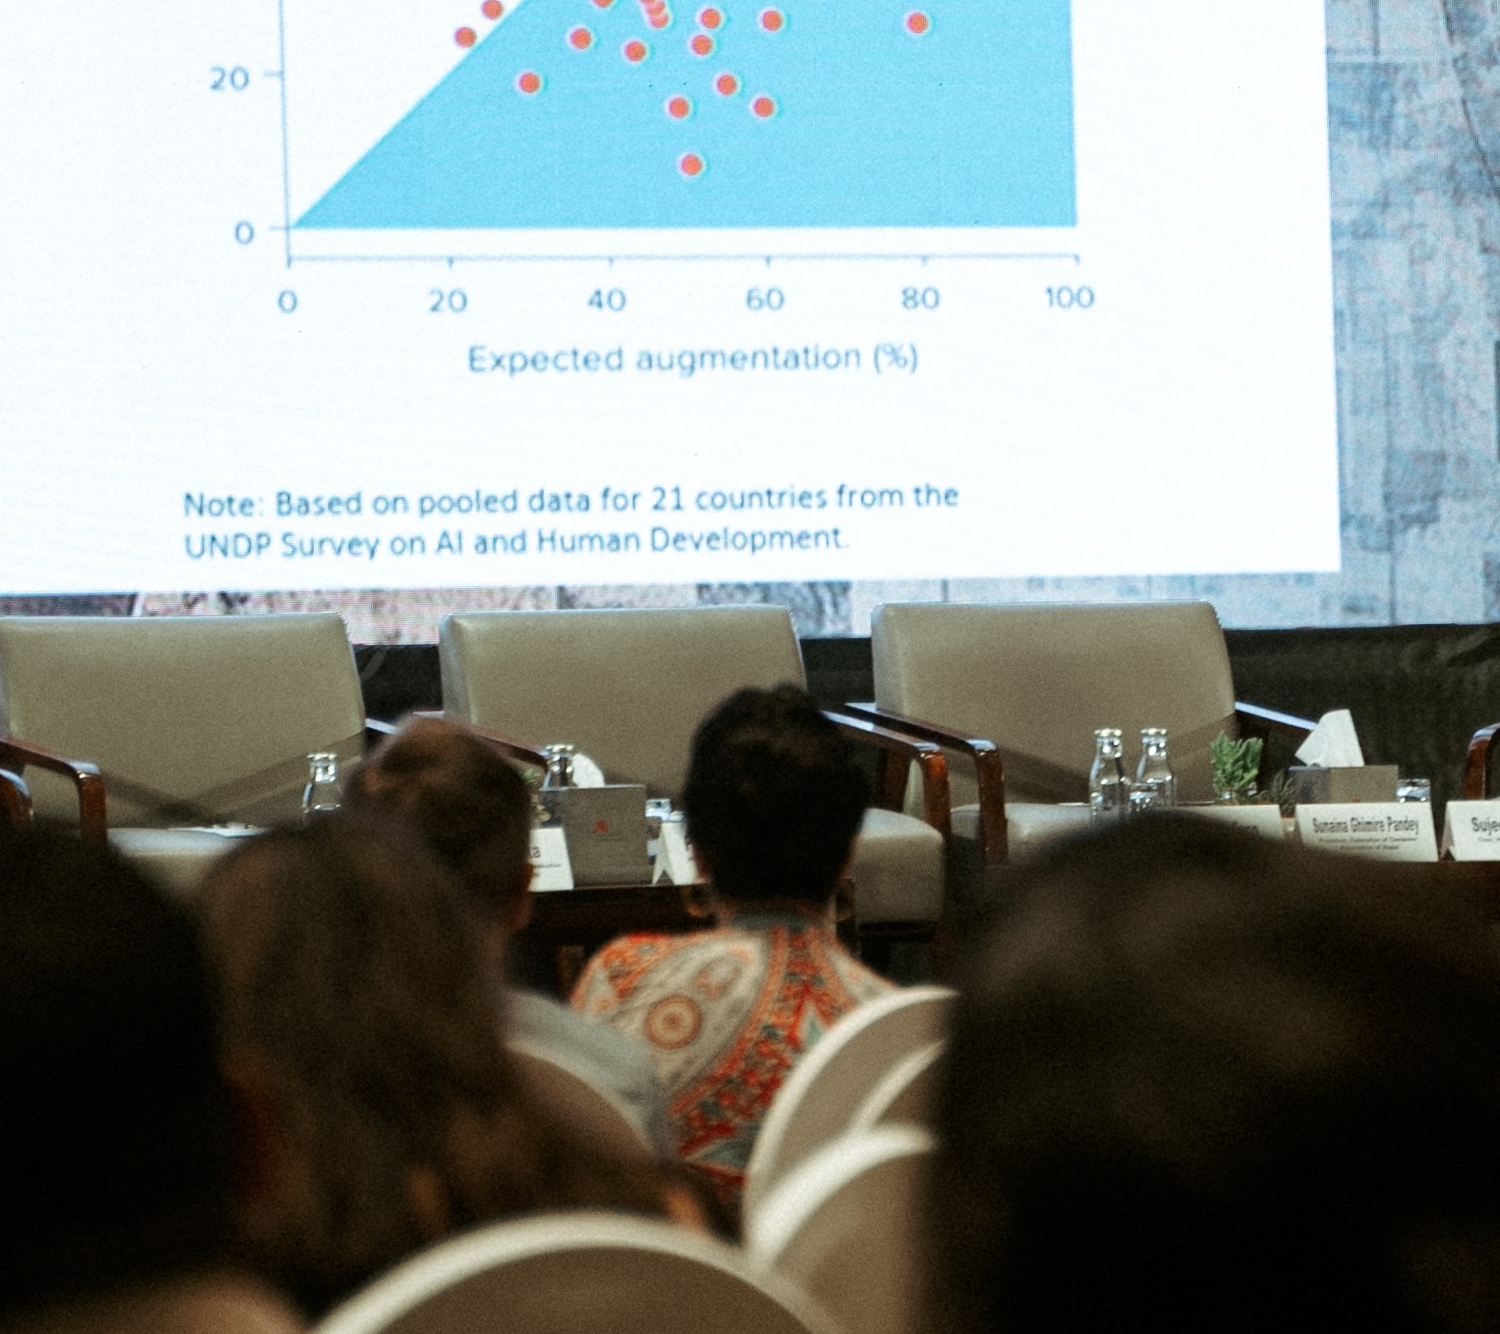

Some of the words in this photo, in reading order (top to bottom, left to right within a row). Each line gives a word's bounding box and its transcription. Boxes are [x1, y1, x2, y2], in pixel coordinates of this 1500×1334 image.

[211, 67, 251, 92] 20
[235, 222, 256, 246] 0
[277, 290, 300, 315] 0
[430, 289, 470, 315] 20
[588, 288, 628, 313] 40
[746, 288, 787, 312] 60
[901, 287, 942, 311] 80
[1046, 286, 1097, 310] 100
[469, 345, 625, 380] Expected
[637, 345, 862, 380] augmentation
[874, 343, 920, 376] (%)
[185, 493, 266, 518] Note:
[276, 491, 363, 518] Based
[373, 496, 409, 516] on
[419, 490, 519, 521] pooled
[529, 489, 592, 514] data
[602, 487, 641, 513] for
[653, 487, 684, 512] 21
[696, 486, 829, 512] countries
[837, 484, 905, 509] from
[914, 484, 960, 508] the
[184, 533, 273, 560] UNDP
[282, 532, 381, 562] Survey
[390, 536, 427, 557] on
[437, 531, 465, 555] AI
[474, 530, 528, 556] and
[538, 529, 642, 555] Human
